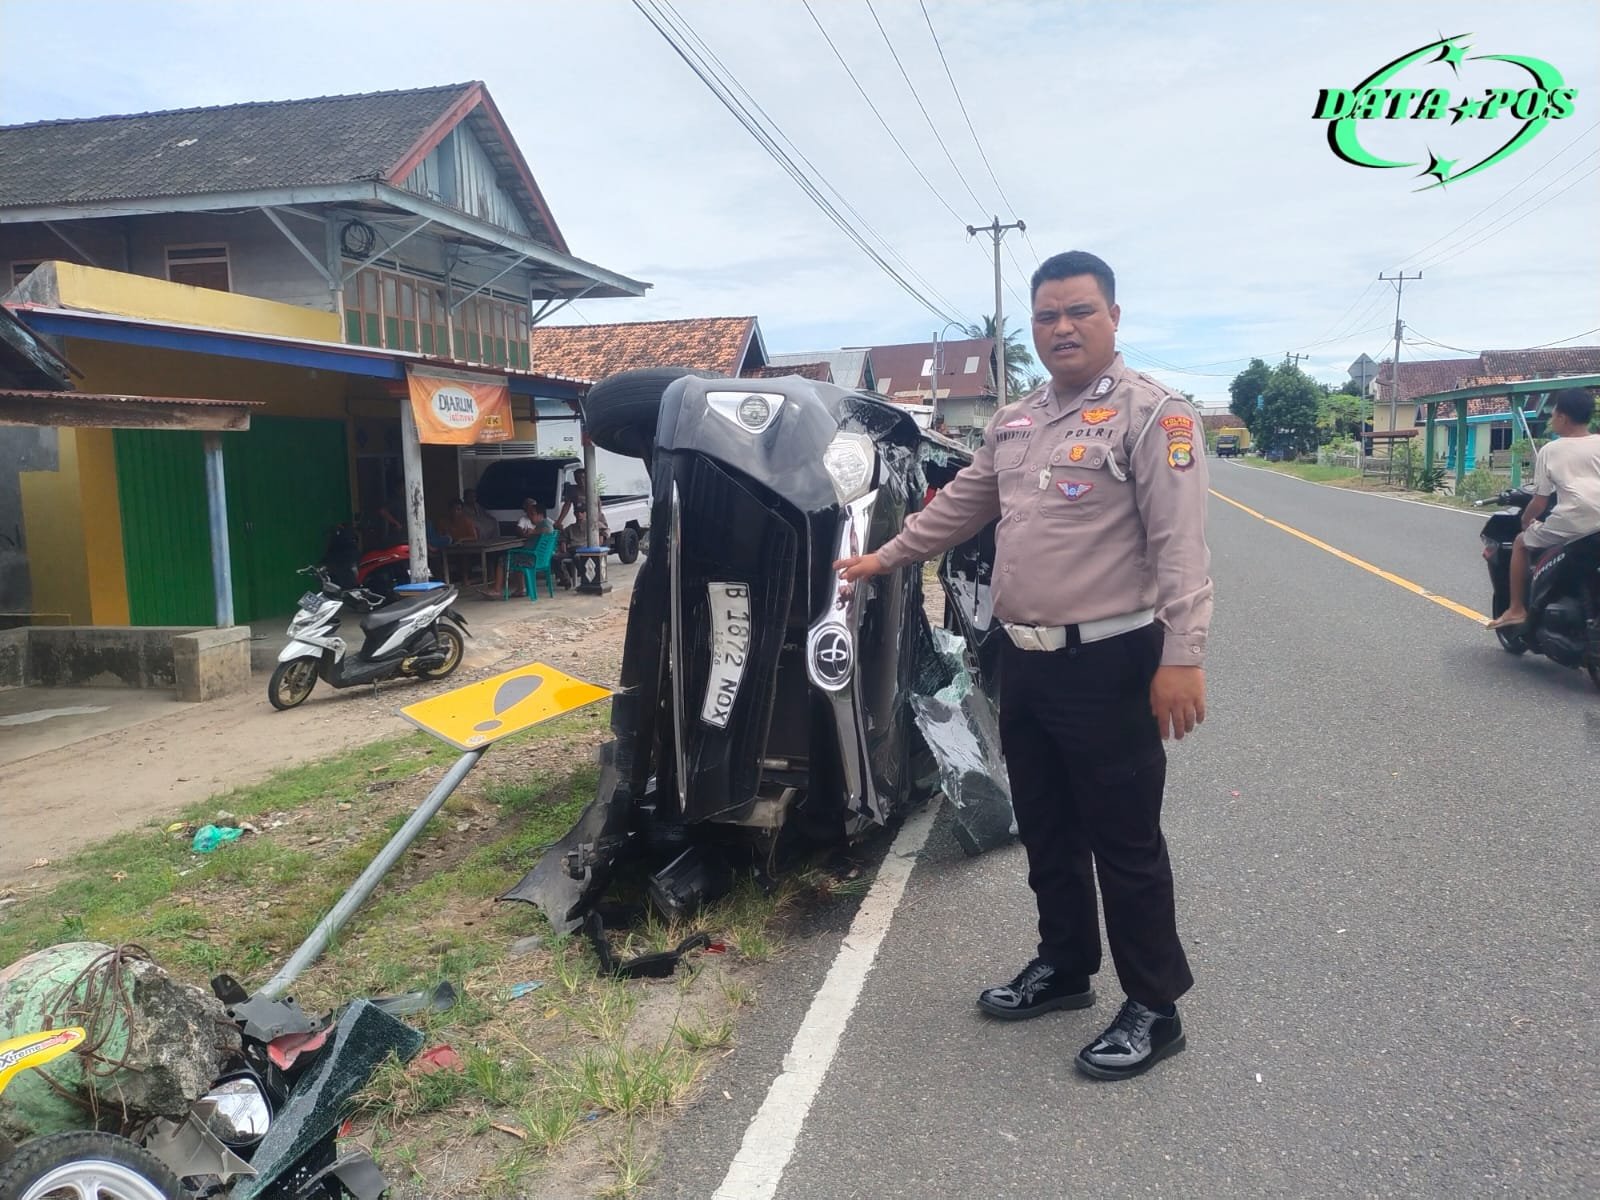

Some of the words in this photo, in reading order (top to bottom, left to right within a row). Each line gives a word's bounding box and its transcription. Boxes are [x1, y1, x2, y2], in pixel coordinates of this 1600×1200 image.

[438, 394, 474, 413] DJARUM
[1064, 427, 1113, 439] POLRI
[725, 586, 749, 599] B
[724, 609, 751, 667] 1872
[711, 677, 738, 721] NOX
